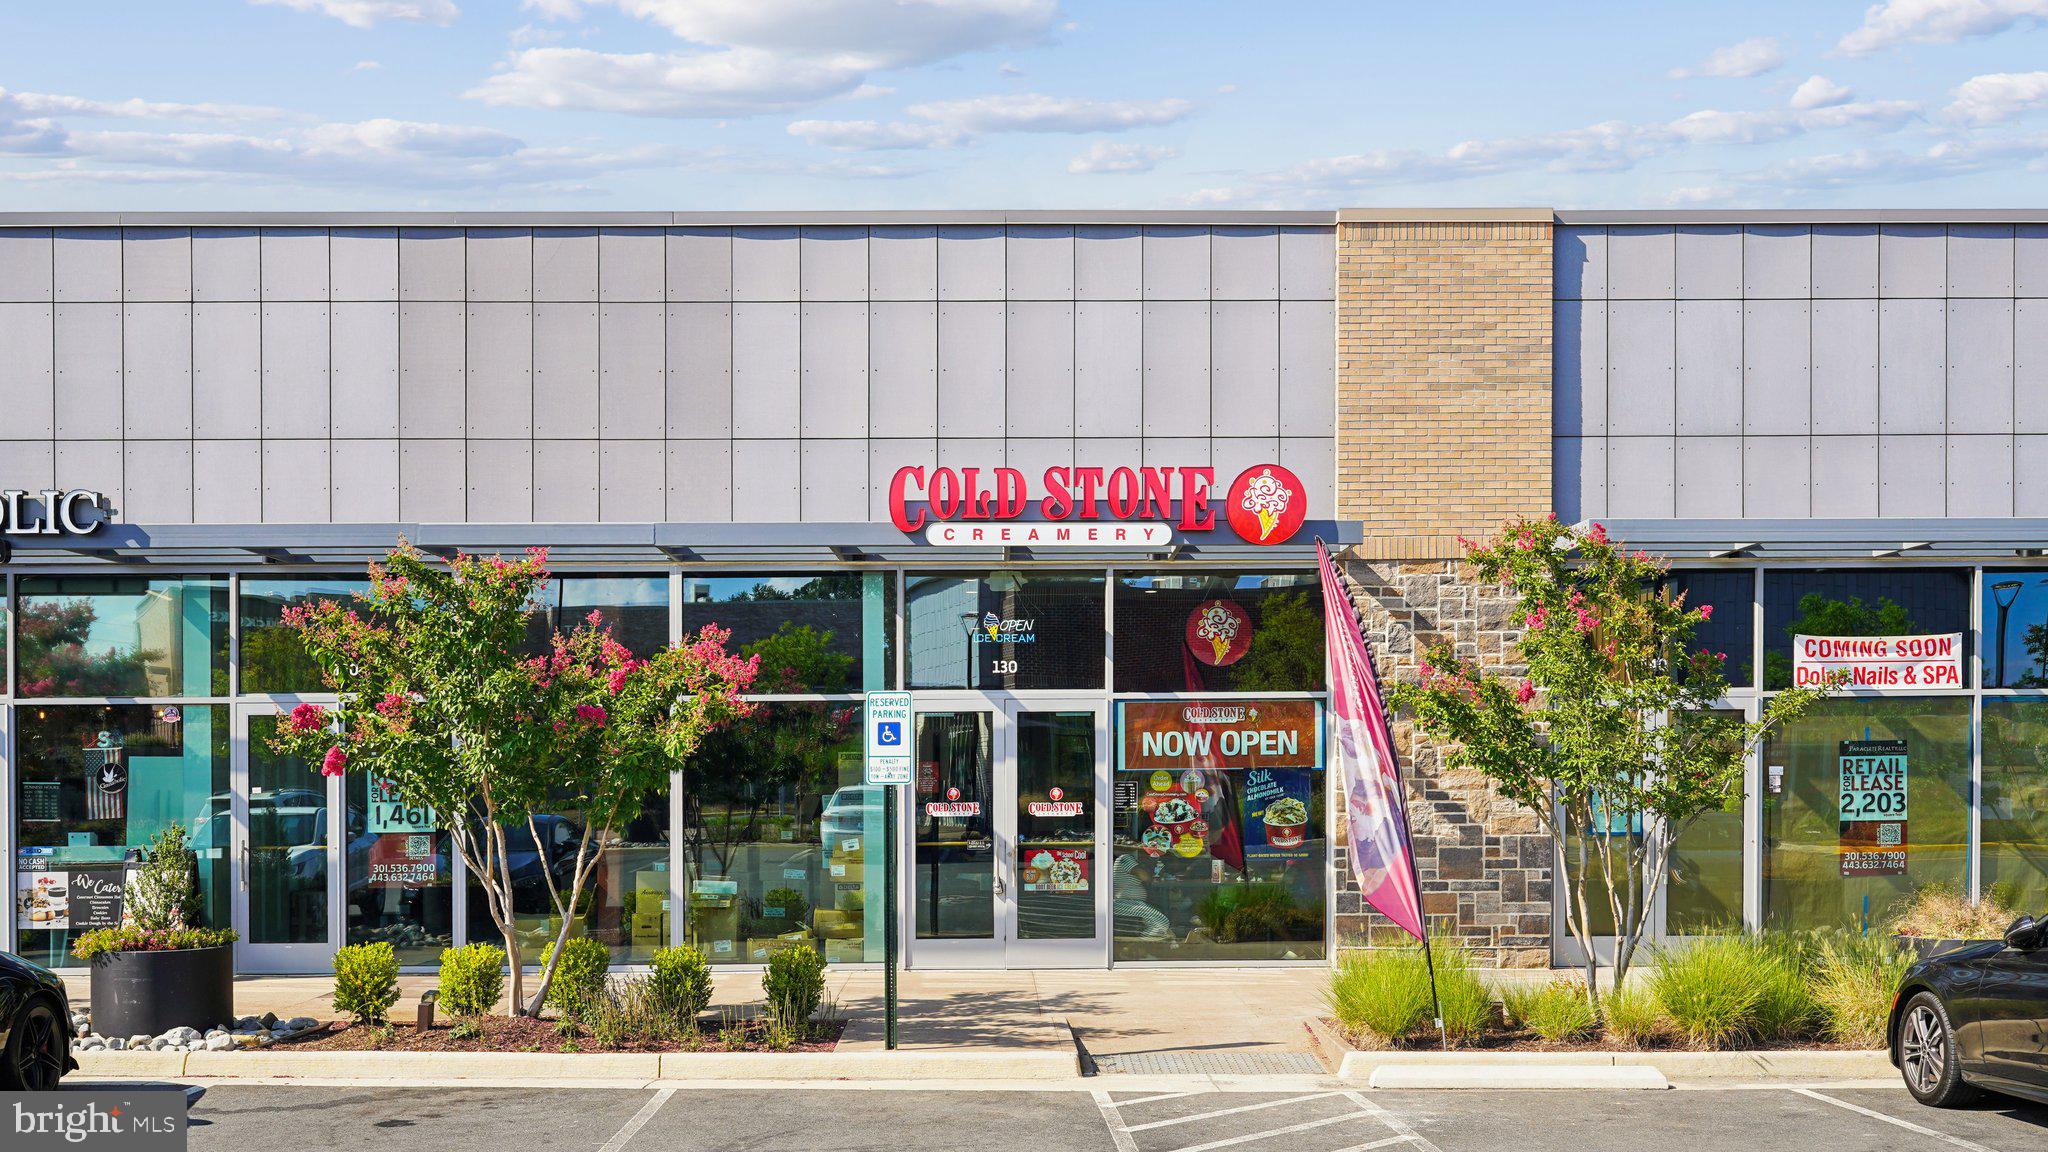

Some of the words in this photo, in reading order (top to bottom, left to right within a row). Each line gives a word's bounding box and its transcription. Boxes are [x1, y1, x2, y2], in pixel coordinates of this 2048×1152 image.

[888, 465, 1027, 533] COLD
[1041, 465, 1215, 532] STONE
[0, 489, 100, 535] LIC
[943, 528, 1154, 541] CREAMERY
[999, 619, 1035, 632] OPEN
[973, 633, 992, 643] ICE
[995, 633, 1035, 643] CREAM
[1804, 639, 1888, 658] COMING
[1895, 637, 1951, 657] SOON
[992, 660, 1018, 674] 130
[1853, 665, 1898, 685] Nails
[1904, 665, 1917, 685] &
[1923, 665, 1959, 685] SPA
[870, 697, 909, 707] RESERVED
[872, 709, 907, 719] PARKING
[1183, 706, 1210, 722] COLD
[1211, 706, 1245, 721] STONE
[1142, 731, 1212, 757] NOW
[1220, 730, 1298, 757] OPEN
[1842, 758, 1904, 775] RETAIL
[1247, 768, 1274, 787] Silk
[1842, 775, 1851, 792] FOR
[1851, 774, 1904, 791] LEASE
[371, 787, 379, 803] FOR
[1246, 781, 1277, 795] CHOCOLATE
[1246, 786, 1284, 801] ALMONDMILK
[926, 803, 949, 815] COLD
[951, 802, 980, 814] STONE
[1029, 802, 1051, 814] COLD
[1053, 802, 1083, 814] STONE
[1841, 792, 1906, 817] 2,203
[375, 804, 429, 829] 1,461
[1844, 851, 1906, 861] 301.536.7900
[373, 864, 435, 873] 301.536.7900
[1842, 860, 1905, 869] 443.632.7464
[71, 873, 95, 890] We
[93, 879, 121, 895] Cater
[371, 872, 435, 882] 443.632.7464
